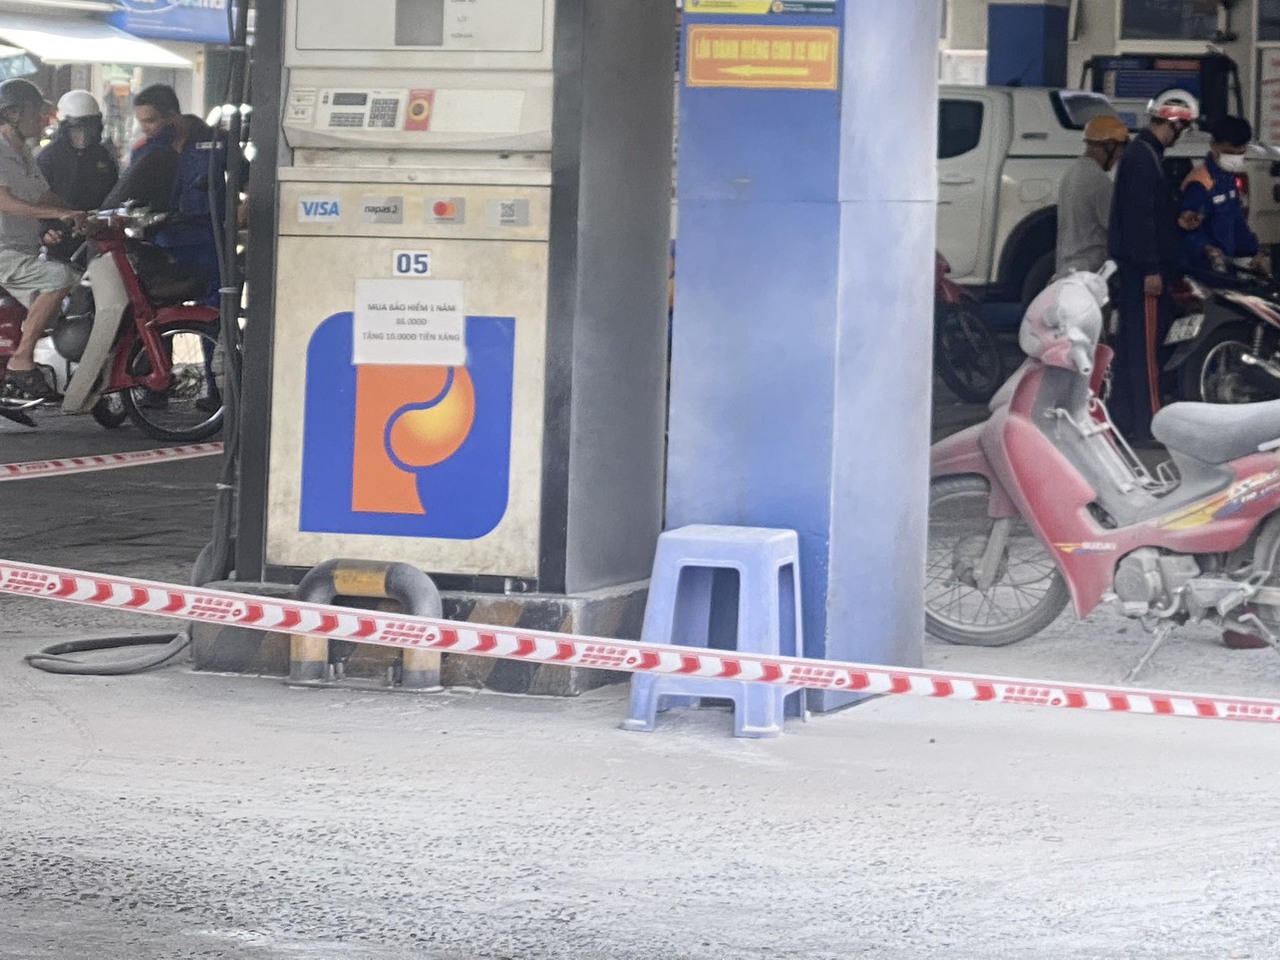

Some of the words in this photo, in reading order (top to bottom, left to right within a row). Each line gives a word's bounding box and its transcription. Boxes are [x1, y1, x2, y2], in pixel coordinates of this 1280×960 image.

[301, 200, 340, 217] VISA
[396, 252, 428, 274] 05
[367, 303, 387, 311] MUA
[389, 302, 406, 311] BẢO
[407, 300, 428, 312] HIỂM
[436, 302, 456, 312] NĂM
